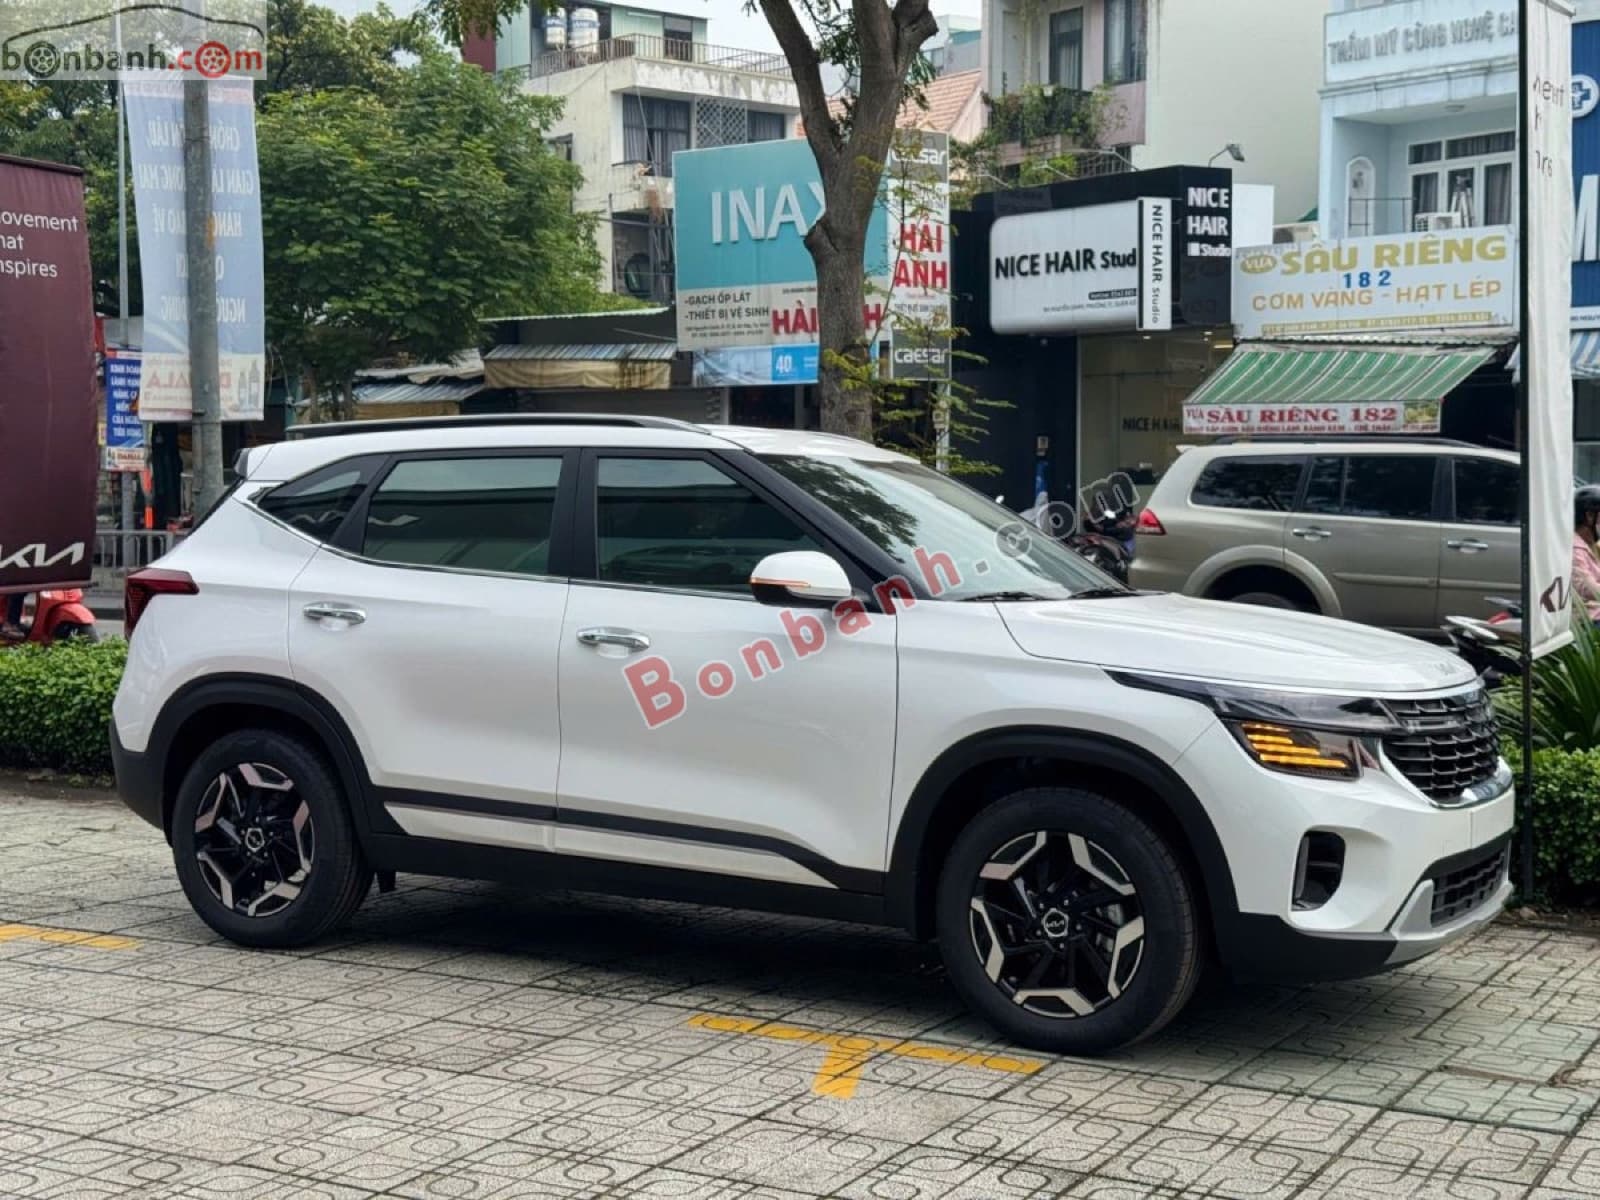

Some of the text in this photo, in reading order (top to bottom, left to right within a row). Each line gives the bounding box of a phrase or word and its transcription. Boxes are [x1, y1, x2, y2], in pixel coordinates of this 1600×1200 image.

[1187, 187, 1230, 209] NICE
[0, 210, 79, 233] ovement
[1187, 215, 1229, 236] HAIR
[1200, 243, 1232, 256] Studio
[1374, 233, 1507, 268] RIÊNG
[894, 259, 948, 289] ANH
[995, 248, 1137, 279] NICE HAIR Stud
[1152, 205, 1162, 324] NICE HAIR Studio
[745, 306, 769, 318] SINH
[776, 354, 793, 373] 40
[1260, 405, 1339, 422] RIÊNG
[1351, 407, 1397, 421] 182
[1122, 416, 1149, 433] NICE
